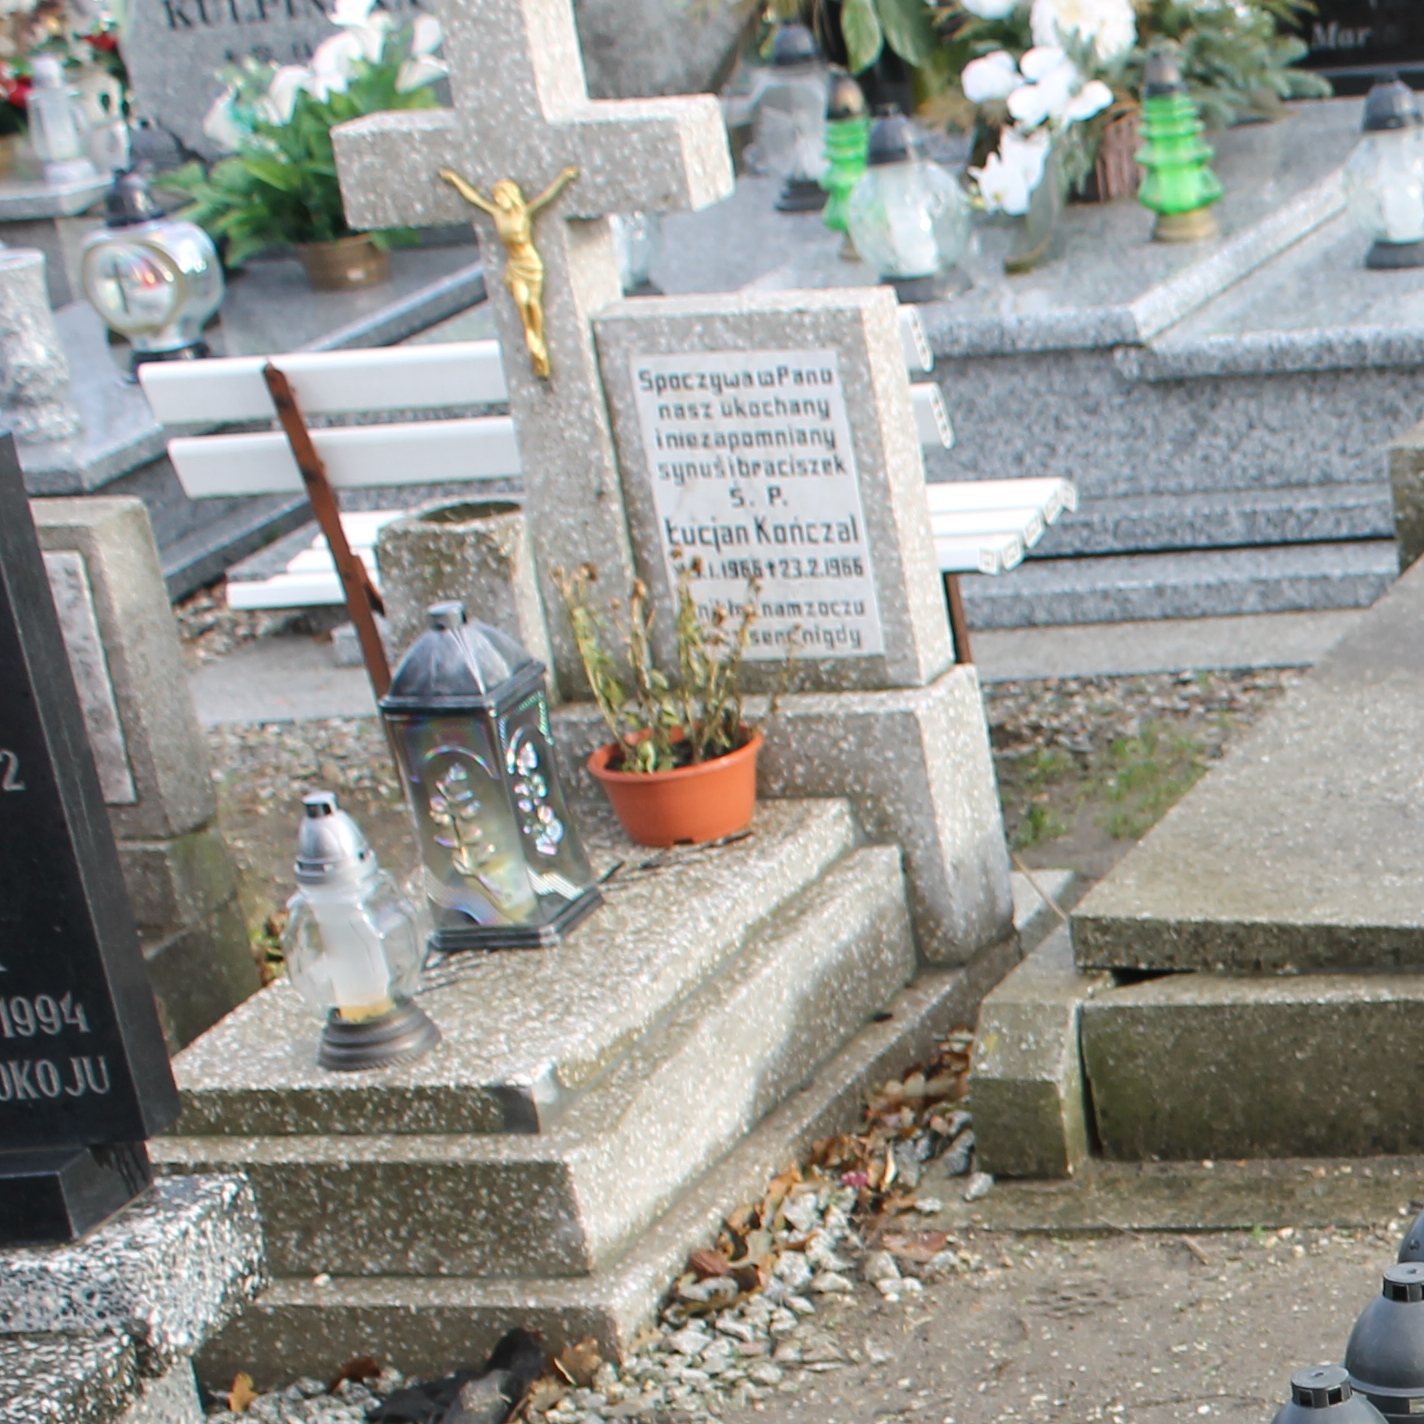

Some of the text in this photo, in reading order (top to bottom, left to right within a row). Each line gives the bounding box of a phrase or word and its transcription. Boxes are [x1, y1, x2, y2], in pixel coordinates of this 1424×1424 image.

[638, 368, 753, 394] Spoczywa
[776, 365, 833, 386] Panu
[658, 397, 830, 420] nasz ukochany
[665, 425, 836, 451] niezapomniany
[737, 454, 847, 477] braciszek
[754, 515, 859, 545] Kończal
[780, 557, 865, 578] 23.2.1966
[762, 601, 803, 617] nam
[818, 600, 865, 616] oczu
[803, 625, 861, 648] nigdy
